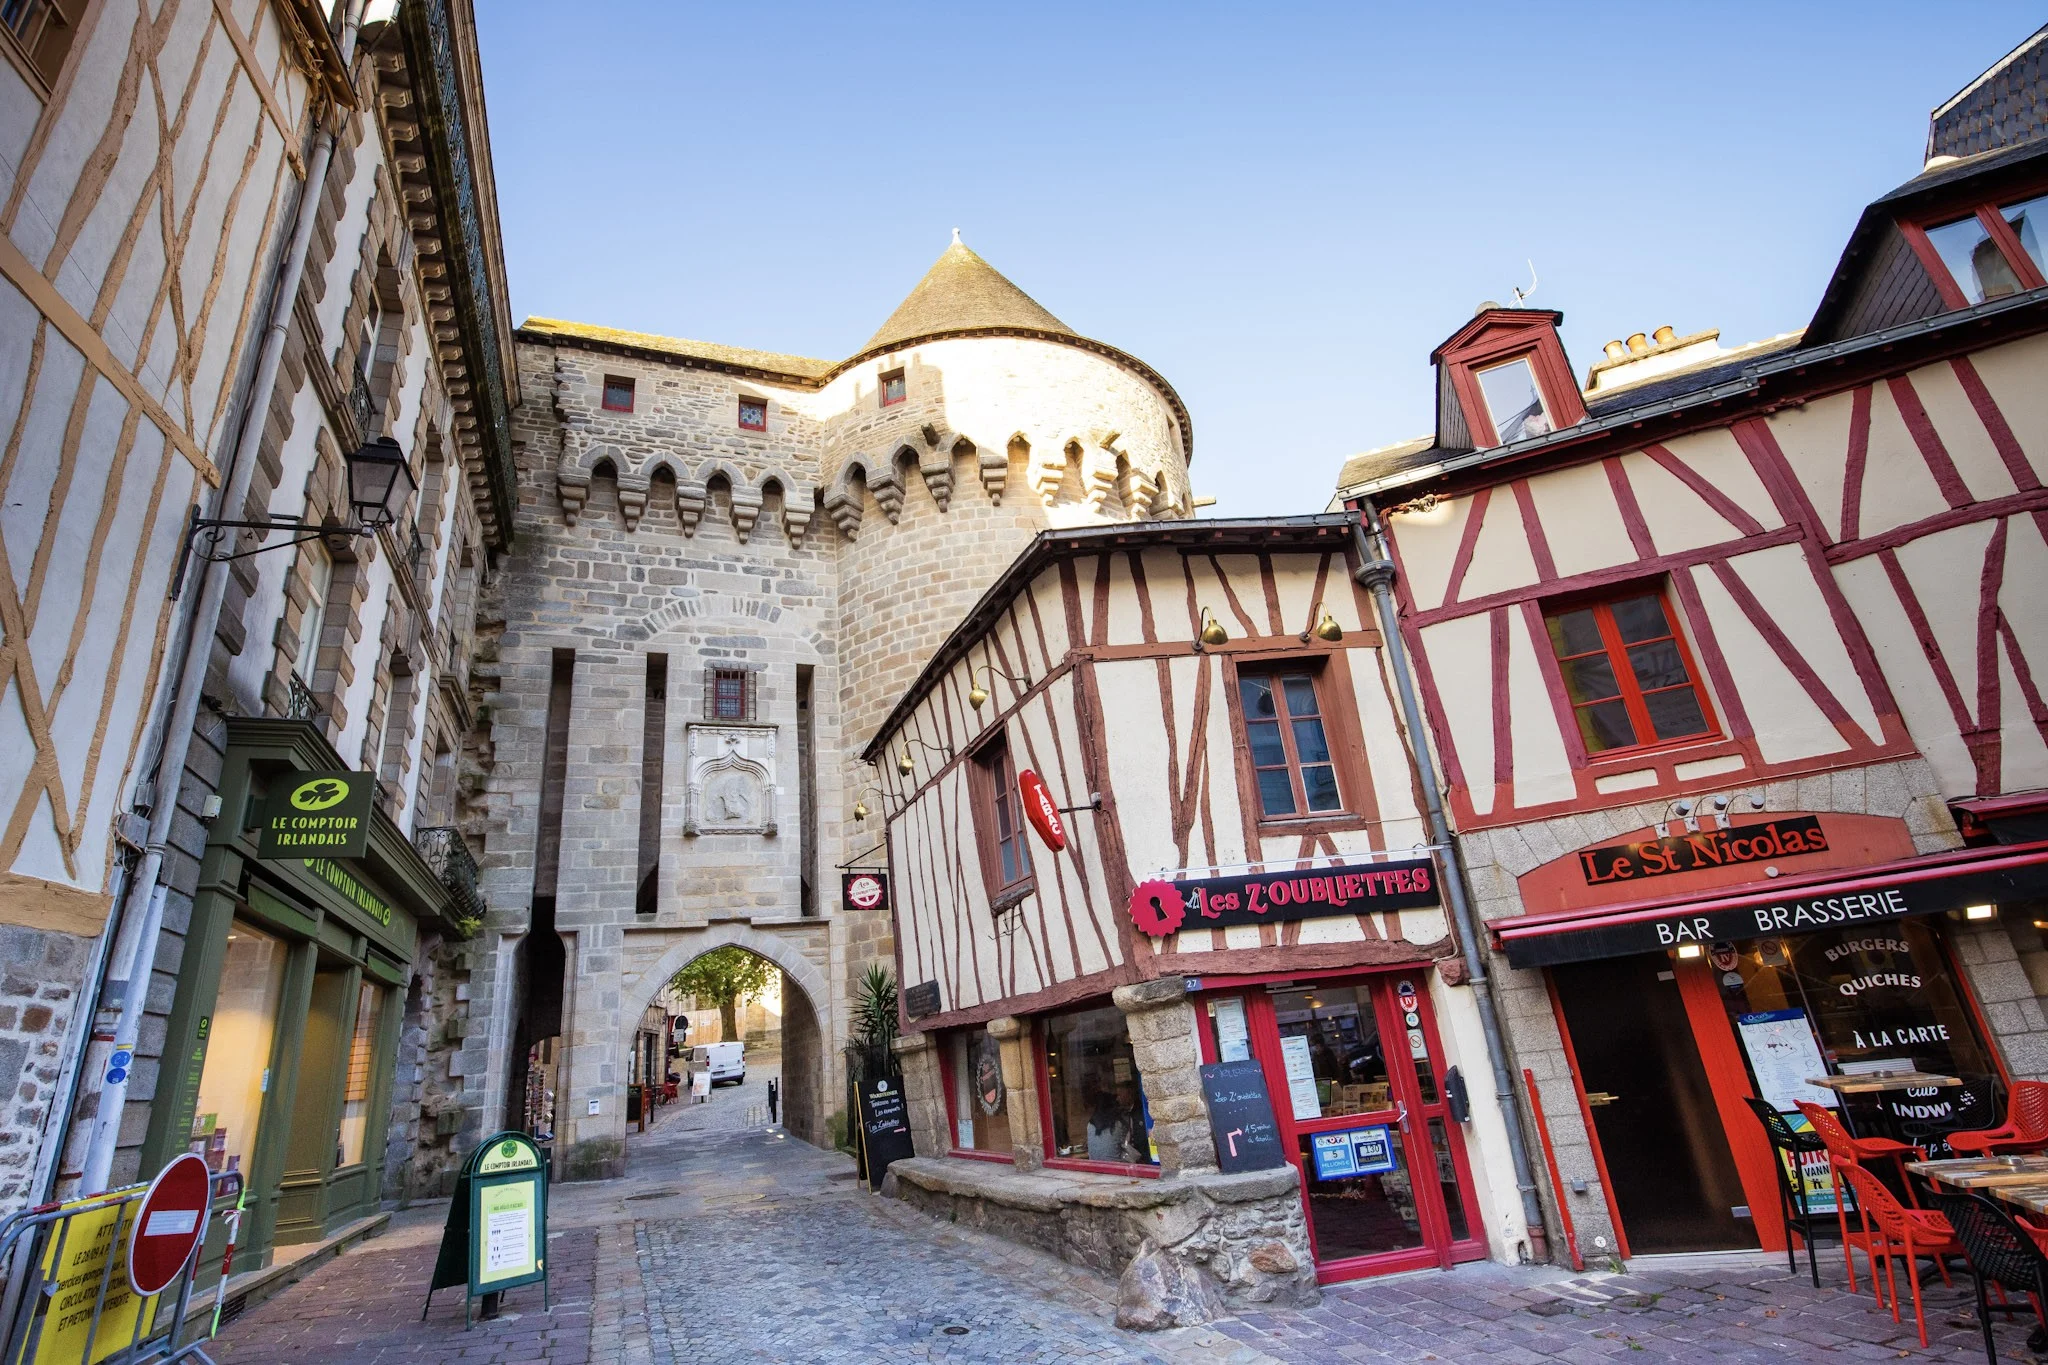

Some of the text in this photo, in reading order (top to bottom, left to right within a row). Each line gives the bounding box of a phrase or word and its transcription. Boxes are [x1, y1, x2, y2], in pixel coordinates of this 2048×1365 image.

[1033, 784, 1061, 834] TABAC
[271, 816, 358, 829] LE COMPTOIR
[277, 833, 347, 845] IRLANDAIS
[1581, 823, 1827, 884] Le St Nicolas
[316, 858, 384, 921] LE COMPTOIR IRLANDAIS
[1245, 867, 1431, 914] Z'OUBLIETTES
[1656, 889, 1908, 945] BAR BRASSERIE
[1824, 938, 1910, 962] BURGERS
[1186, 979, 1197, 989] 27
[1839, 973, 1921, 996] QUICHES
[1853, 1024, 1951, 1049] À LA CARTE
[1332, 1150, 1338, 1158] 5
[1365, 1144, 1379, 1154] 130
[484, 1159, 533, 1171] LE COMPTOIR IRLANDAIS
[73, 1251, 82, 1266] LE
[57, 1316, 68, 1333] ET
